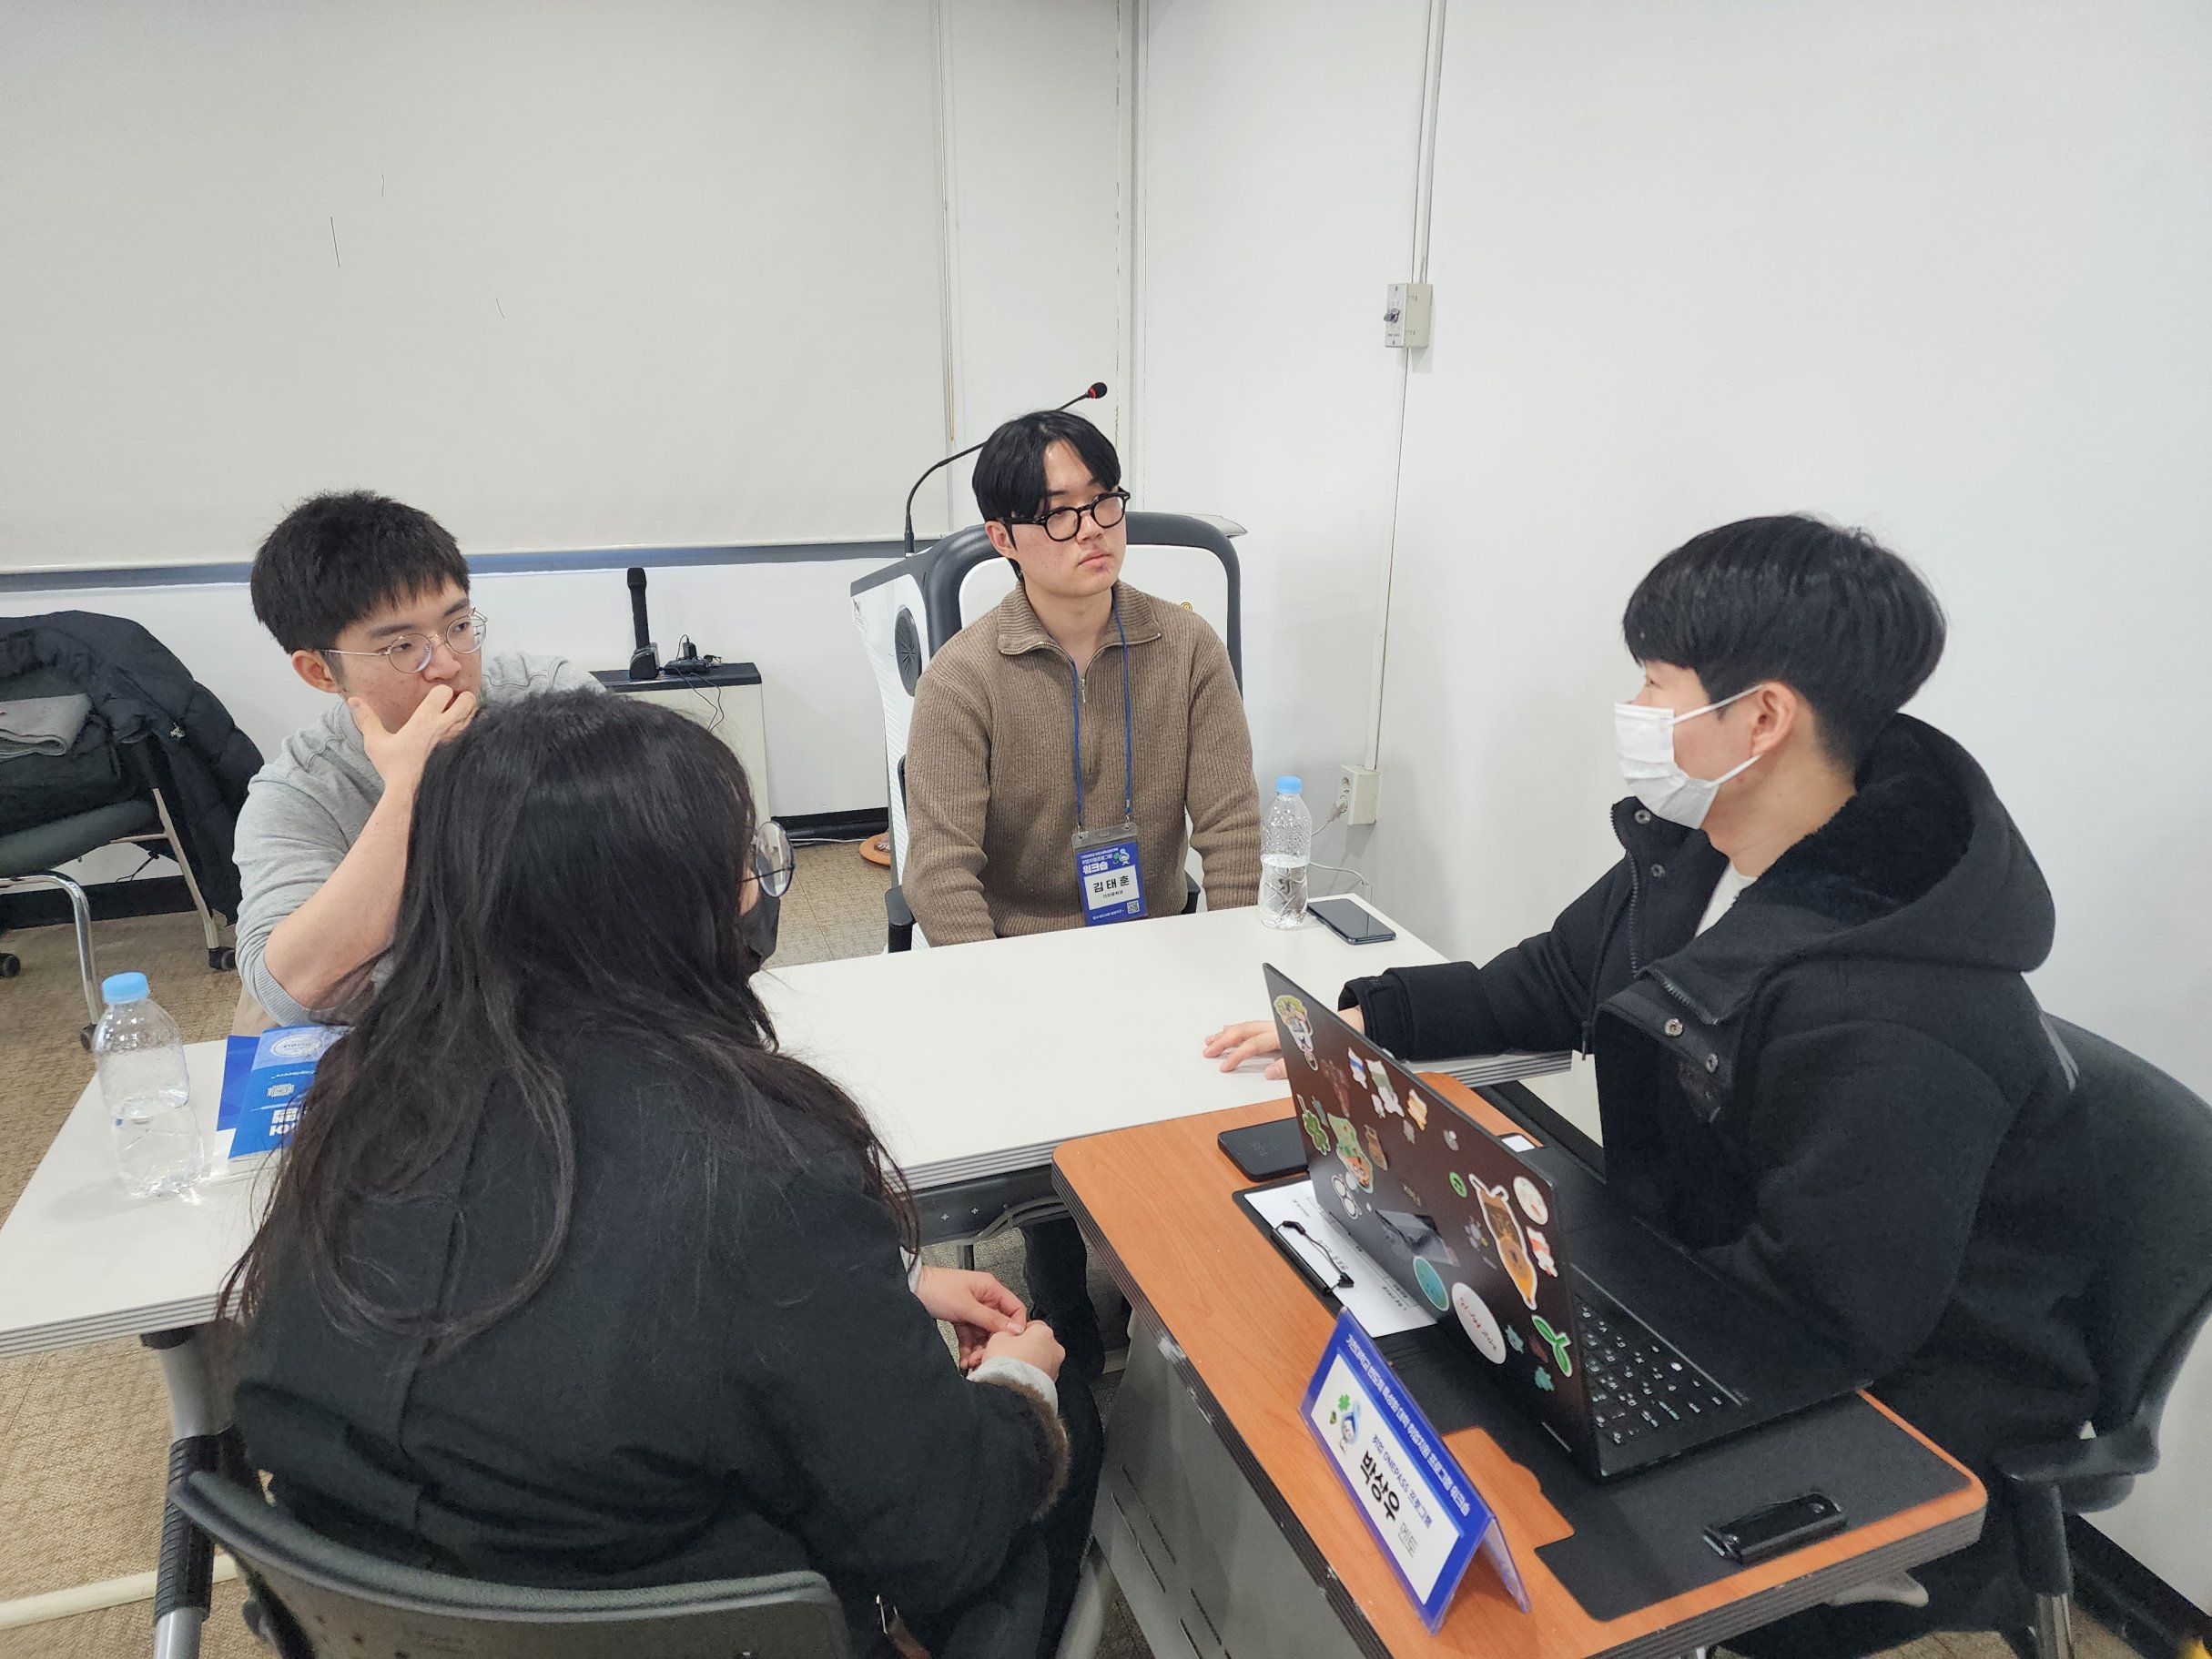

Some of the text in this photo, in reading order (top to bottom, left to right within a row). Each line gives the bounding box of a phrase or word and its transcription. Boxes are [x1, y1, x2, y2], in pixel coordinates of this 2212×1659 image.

[1082, 861, 1108, 874] 워크숍
[1367, 1366, 1385, 1391] 반도체
[1382, 1386, 1400, 1412] 특성화
[1396, 1407, 1410, 1428] 대학
[1407, 1423, 1431, 1459] 취업지원
[1427, 1452, 1454, 1491] 프로그램
[1450, 1485, 1470, 1516] 워크숍
[1373, 1434, 1432, 1528] 취업 ONEPASS 프로그램
[1360, 1450, 1416, 1557] 박상우 멘토
